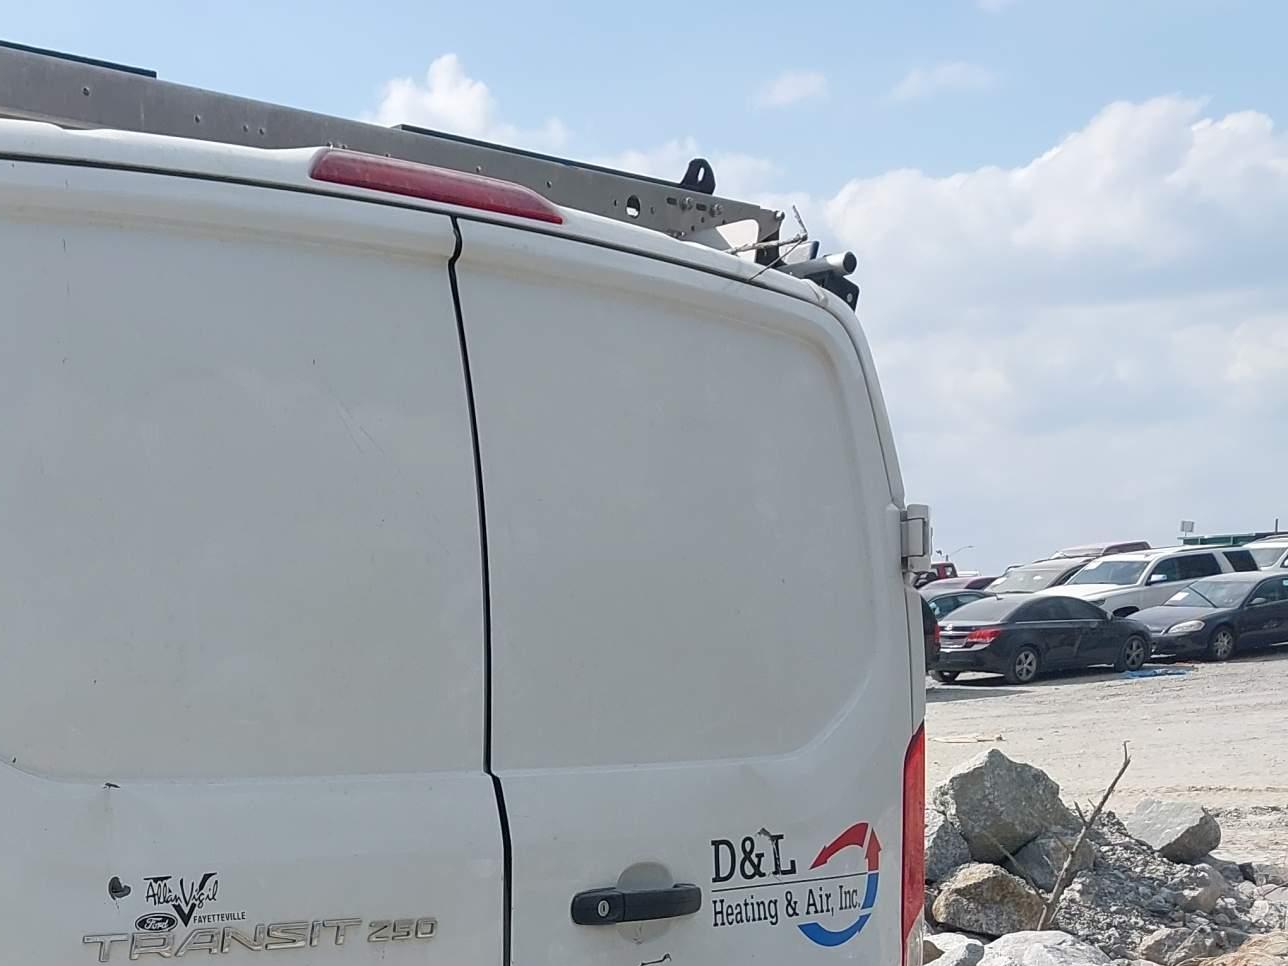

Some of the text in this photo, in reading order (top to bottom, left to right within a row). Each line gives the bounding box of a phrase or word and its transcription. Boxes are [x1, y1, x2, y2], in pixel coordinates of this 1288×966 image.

[711, 834, 797, 883] D&L
[193, 912, 246, 924] FAYETTEVILLE
[712, 885, 861, 927] Heating & Air, Inc.
[82, 916, 438, 963] TRANSIT 250
